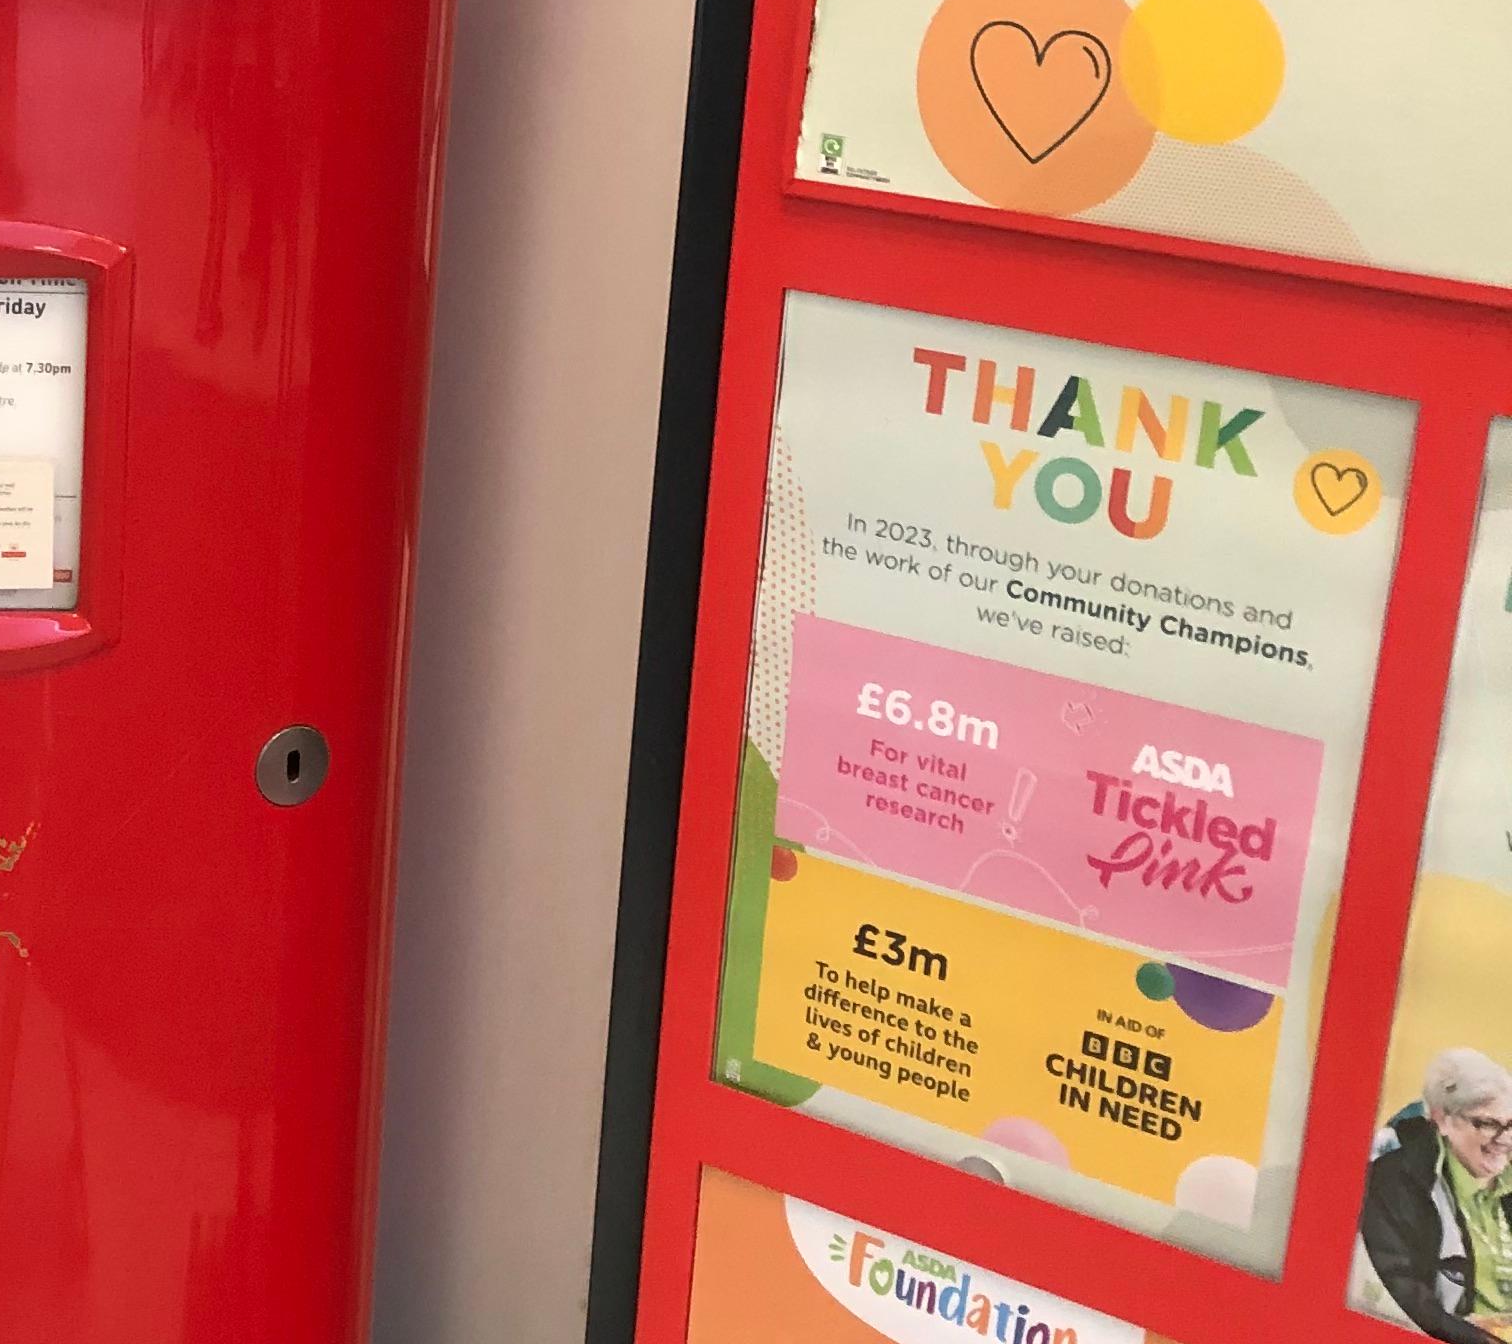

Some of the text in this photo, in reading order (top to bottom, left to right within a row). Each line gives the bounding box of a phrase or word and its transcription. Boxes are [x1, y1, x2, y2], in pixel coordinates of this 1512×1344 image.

[26, 362, 72, 376] 7.30pm
[913, 346, 1266, 477] THANK
[979, 440, 1174, 540] YOU
[822, 536, 858, 561] the
[866, 549, 920, 576] work
[928, 562, 952, 583] of
[958, 571, 999, 593] our
[1006, 579, 1152, 633] Community
[846, 512, 867, 535] In
[946, 533, 1039, 573] through
[1047, 557, 1102, 586] your
[1110, 572, 1235, 618] donations
[1242, 604, 1293, 631] and
[977, 605, 1043, 636] we've
[856, 682, 999, 750] £6.8m
[837, 755, 995, 815] breast cancer
[869, 738, 967, 782] For vital
[1132, 743, 1235, 799] ASDA
[865, 793, 965, 835] research
[1086, 770, 1277, 862] Tickled
[1086, 831, 1254, 905] Pink
[853, 923, 948, 981] £3m
[804, 983, 979, 1055] difference to the
[815, 960, 972, 1028] To help make a
[805, 1006, 972, 1078] lives of children
[806, 1032, 971, 1103] & young people
[1045, 1053, 1202, 1123] CHILDREN
[1059, 1083, 1182, 1142] IN NEED
[902, 1249, 958, 1283] ASDA
